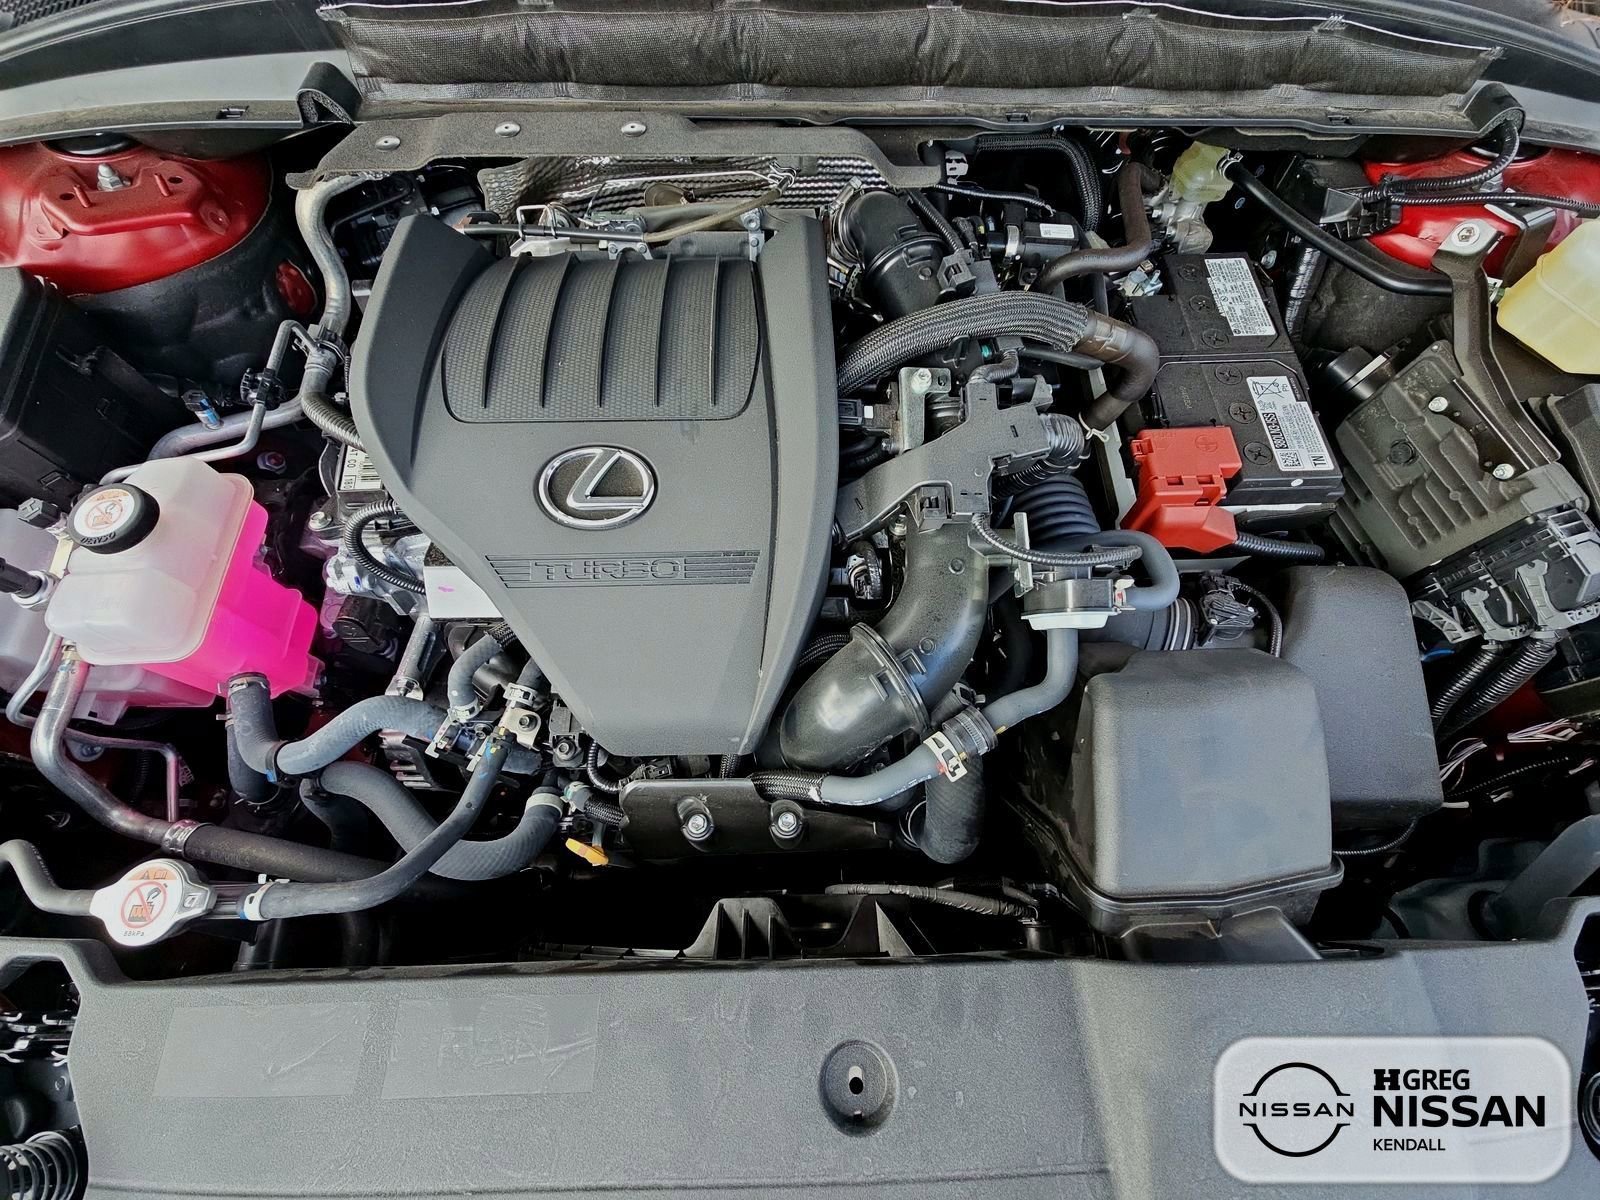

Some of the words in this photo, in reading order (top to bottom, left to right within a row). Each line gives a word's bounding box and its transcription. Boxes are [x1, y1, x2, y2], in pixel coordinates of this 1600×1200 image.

[1311, 455, 1327, 467] TN
[80, 531, 117, 545] DENSO
[534, 558, 682, 581] TURBO
